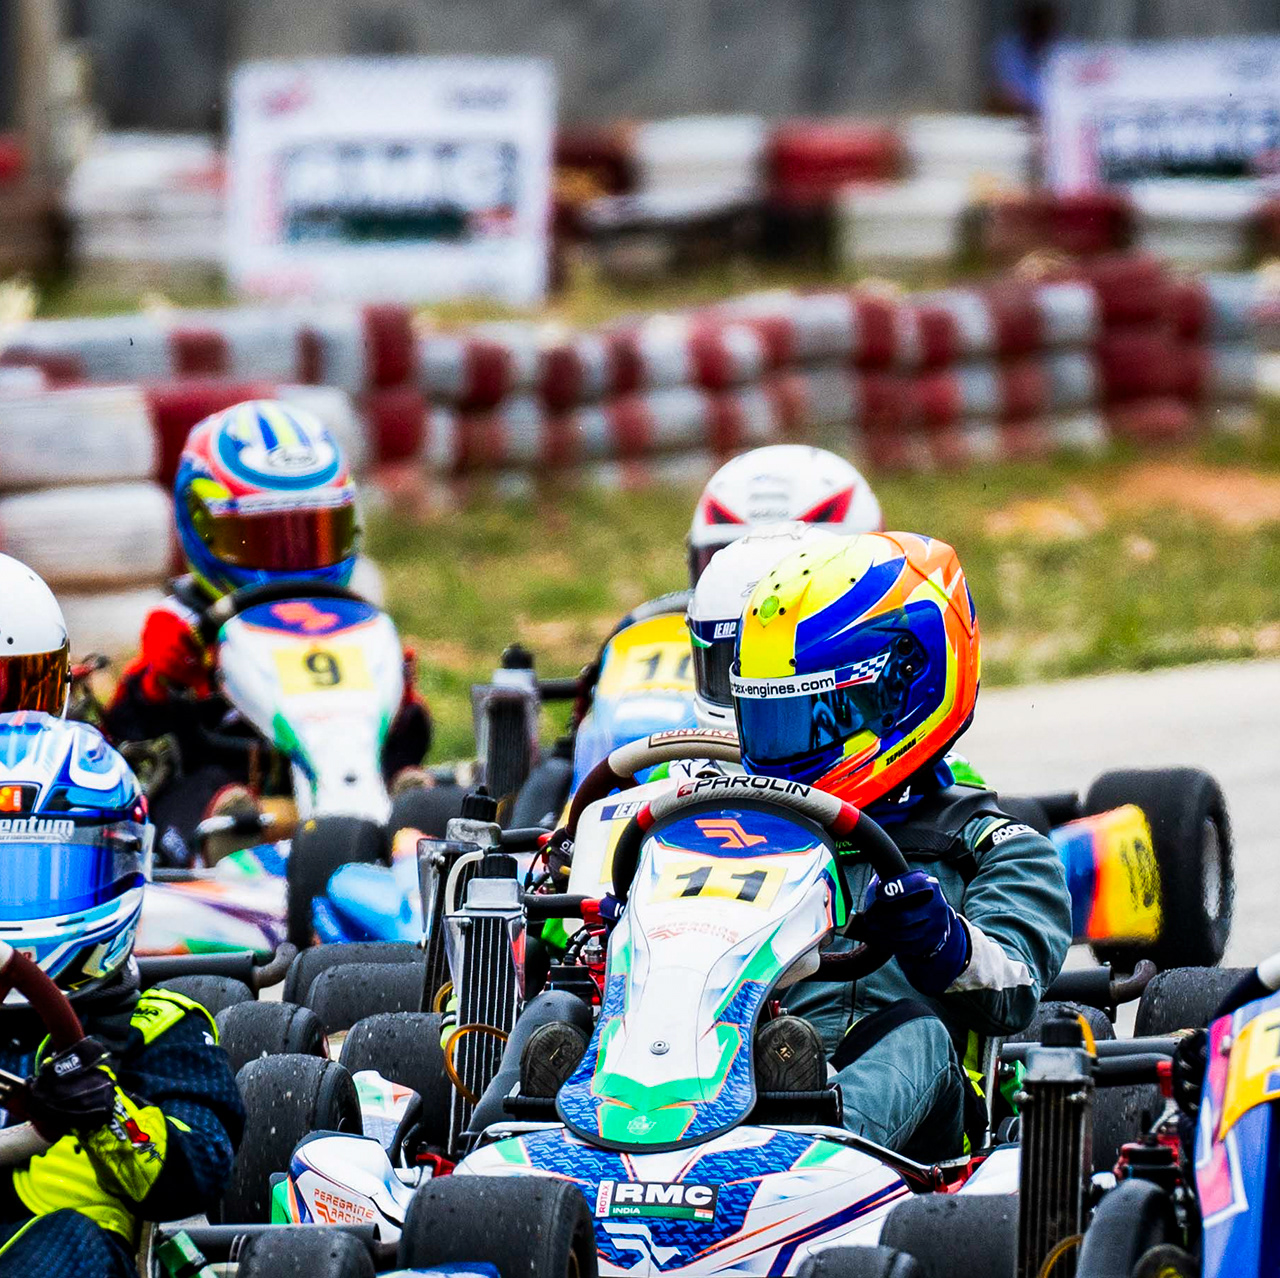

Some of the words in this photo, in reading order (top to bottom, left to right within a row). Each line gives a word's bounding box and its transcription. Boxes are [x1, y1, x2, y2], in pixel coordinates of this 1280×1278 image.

[305, 651, 342, 687] 9
[694, 775, 811, 798] PAROLIN
[676, 866, 768, 903] 11
[54, 1056, 80, 1074] OMP
[314, 1188, 375, 1219] PEREGRINE
[598, 1184, 610, 1214] ROTAX
[615, 1183, 713, 1206] RMC
